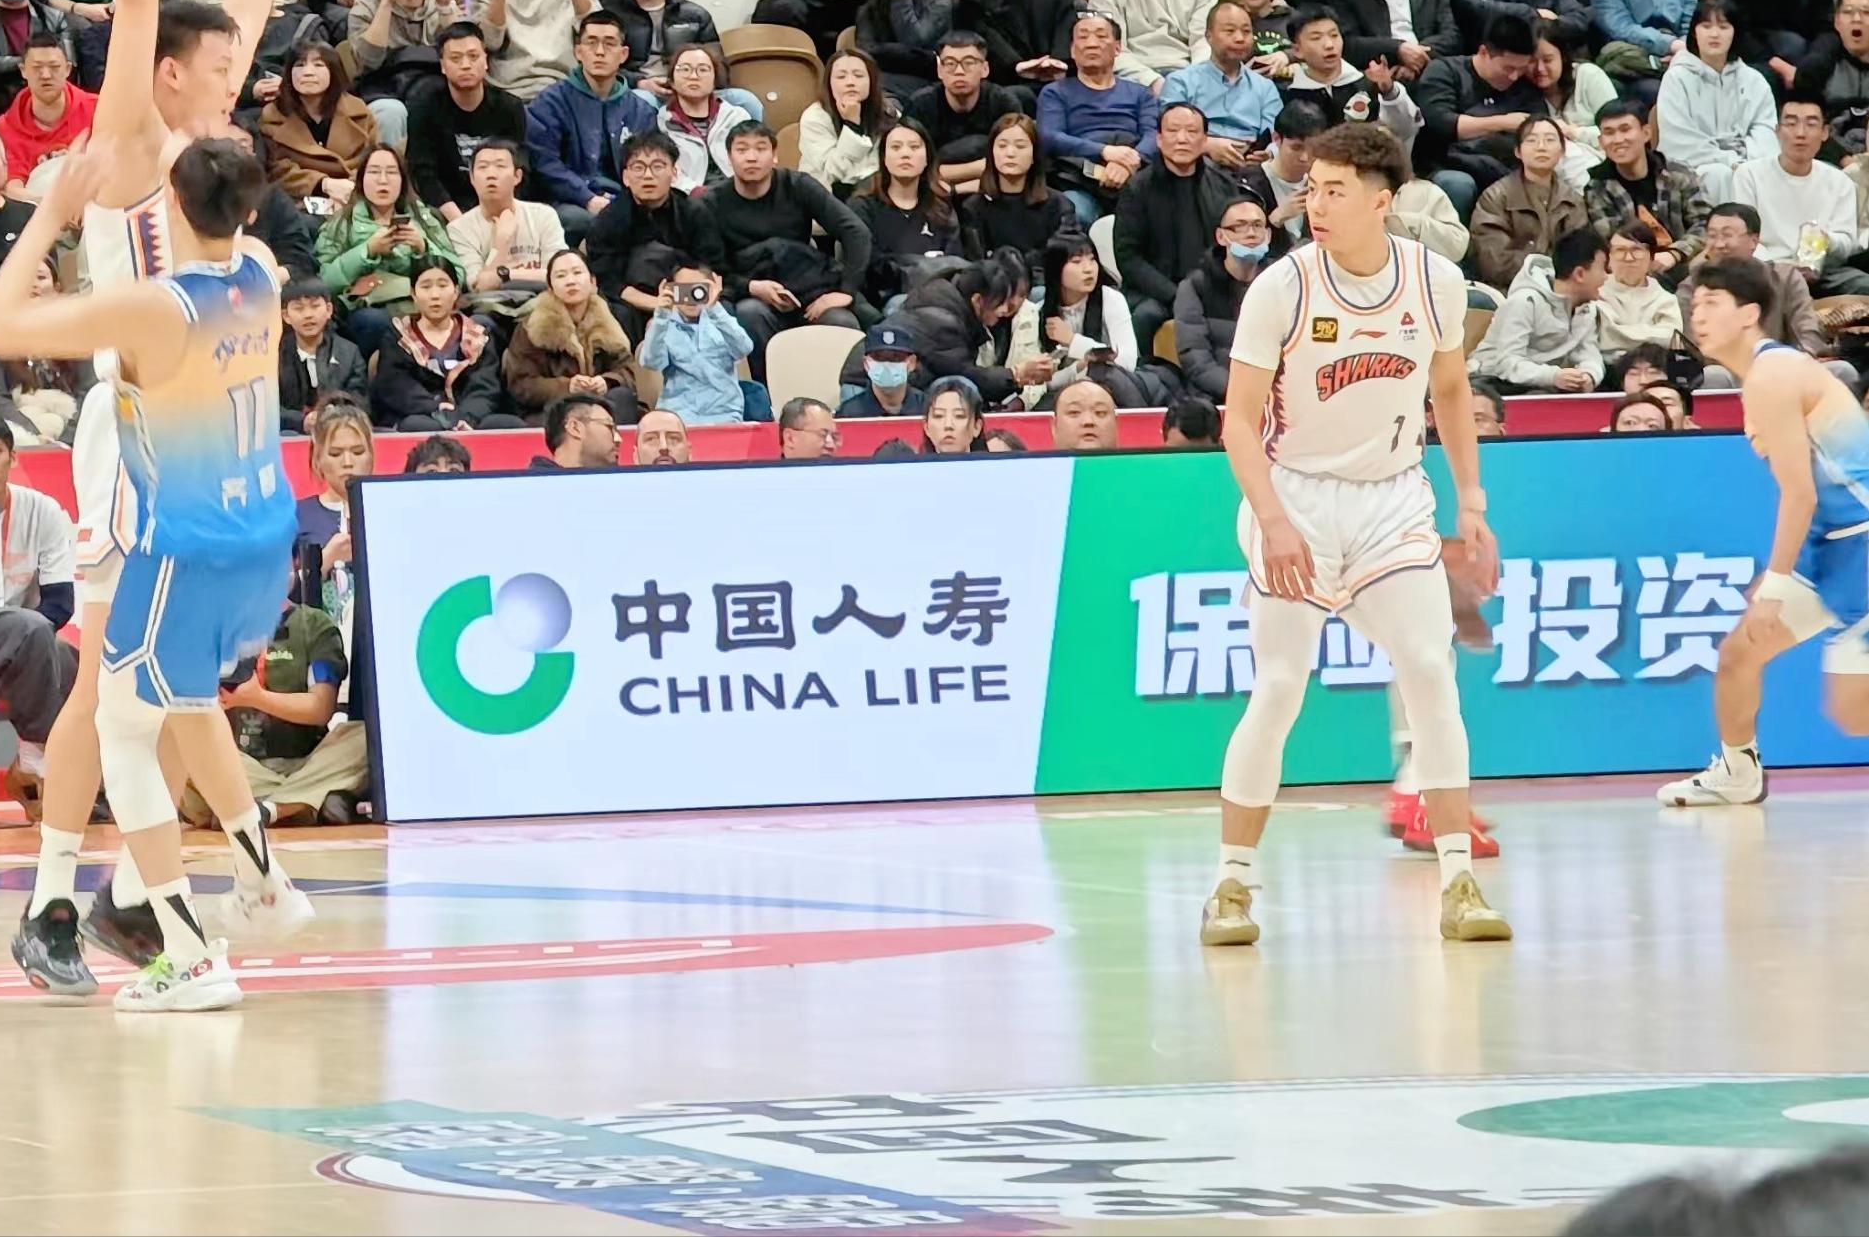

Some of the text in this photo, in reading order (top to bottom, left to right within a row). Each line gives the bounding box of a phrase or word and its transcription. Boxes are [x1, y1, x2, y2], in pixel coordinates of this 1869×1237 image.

[1316, 352, 1417, 402] SHARKS
[227, 375, 266, 461] 11
[611, 570, 1011, 660] 中国人寿
[619, 664, 1011, 717] CHINA LIFE
